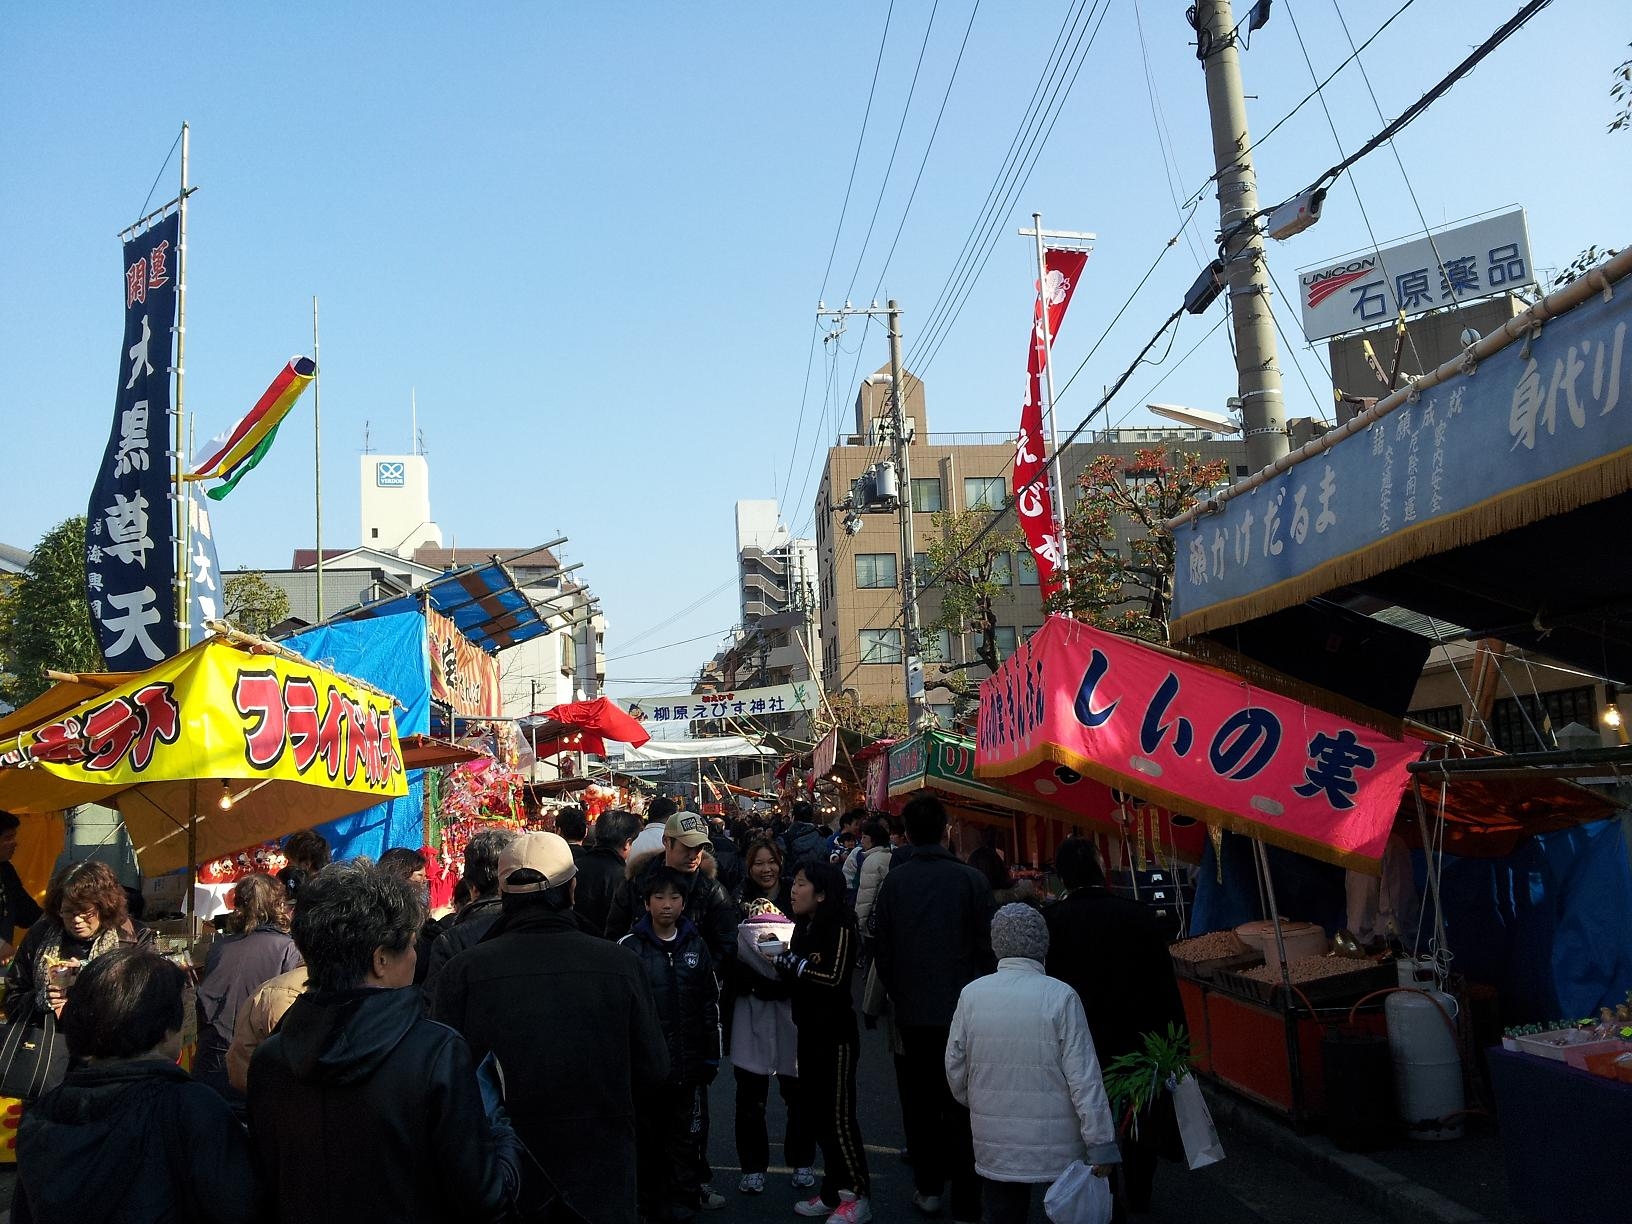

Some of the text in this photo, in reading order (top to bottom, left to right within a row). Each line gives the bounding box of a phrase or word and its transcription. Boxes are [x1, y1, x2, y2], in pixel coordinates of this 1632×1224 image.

[125, 239, 170, 310] 開運
[1350, 242, 1526, 321] 石原薬品
[1509, 321, 1627, 452] 身代り
[102, 314, 166, 662] 大黒尊天
[1189, 465, 1337, 586] 願かけだるま
[654, 695, 786, 721] 柳原えびす神社
[1073, 647, 1378, 811] しいの実
